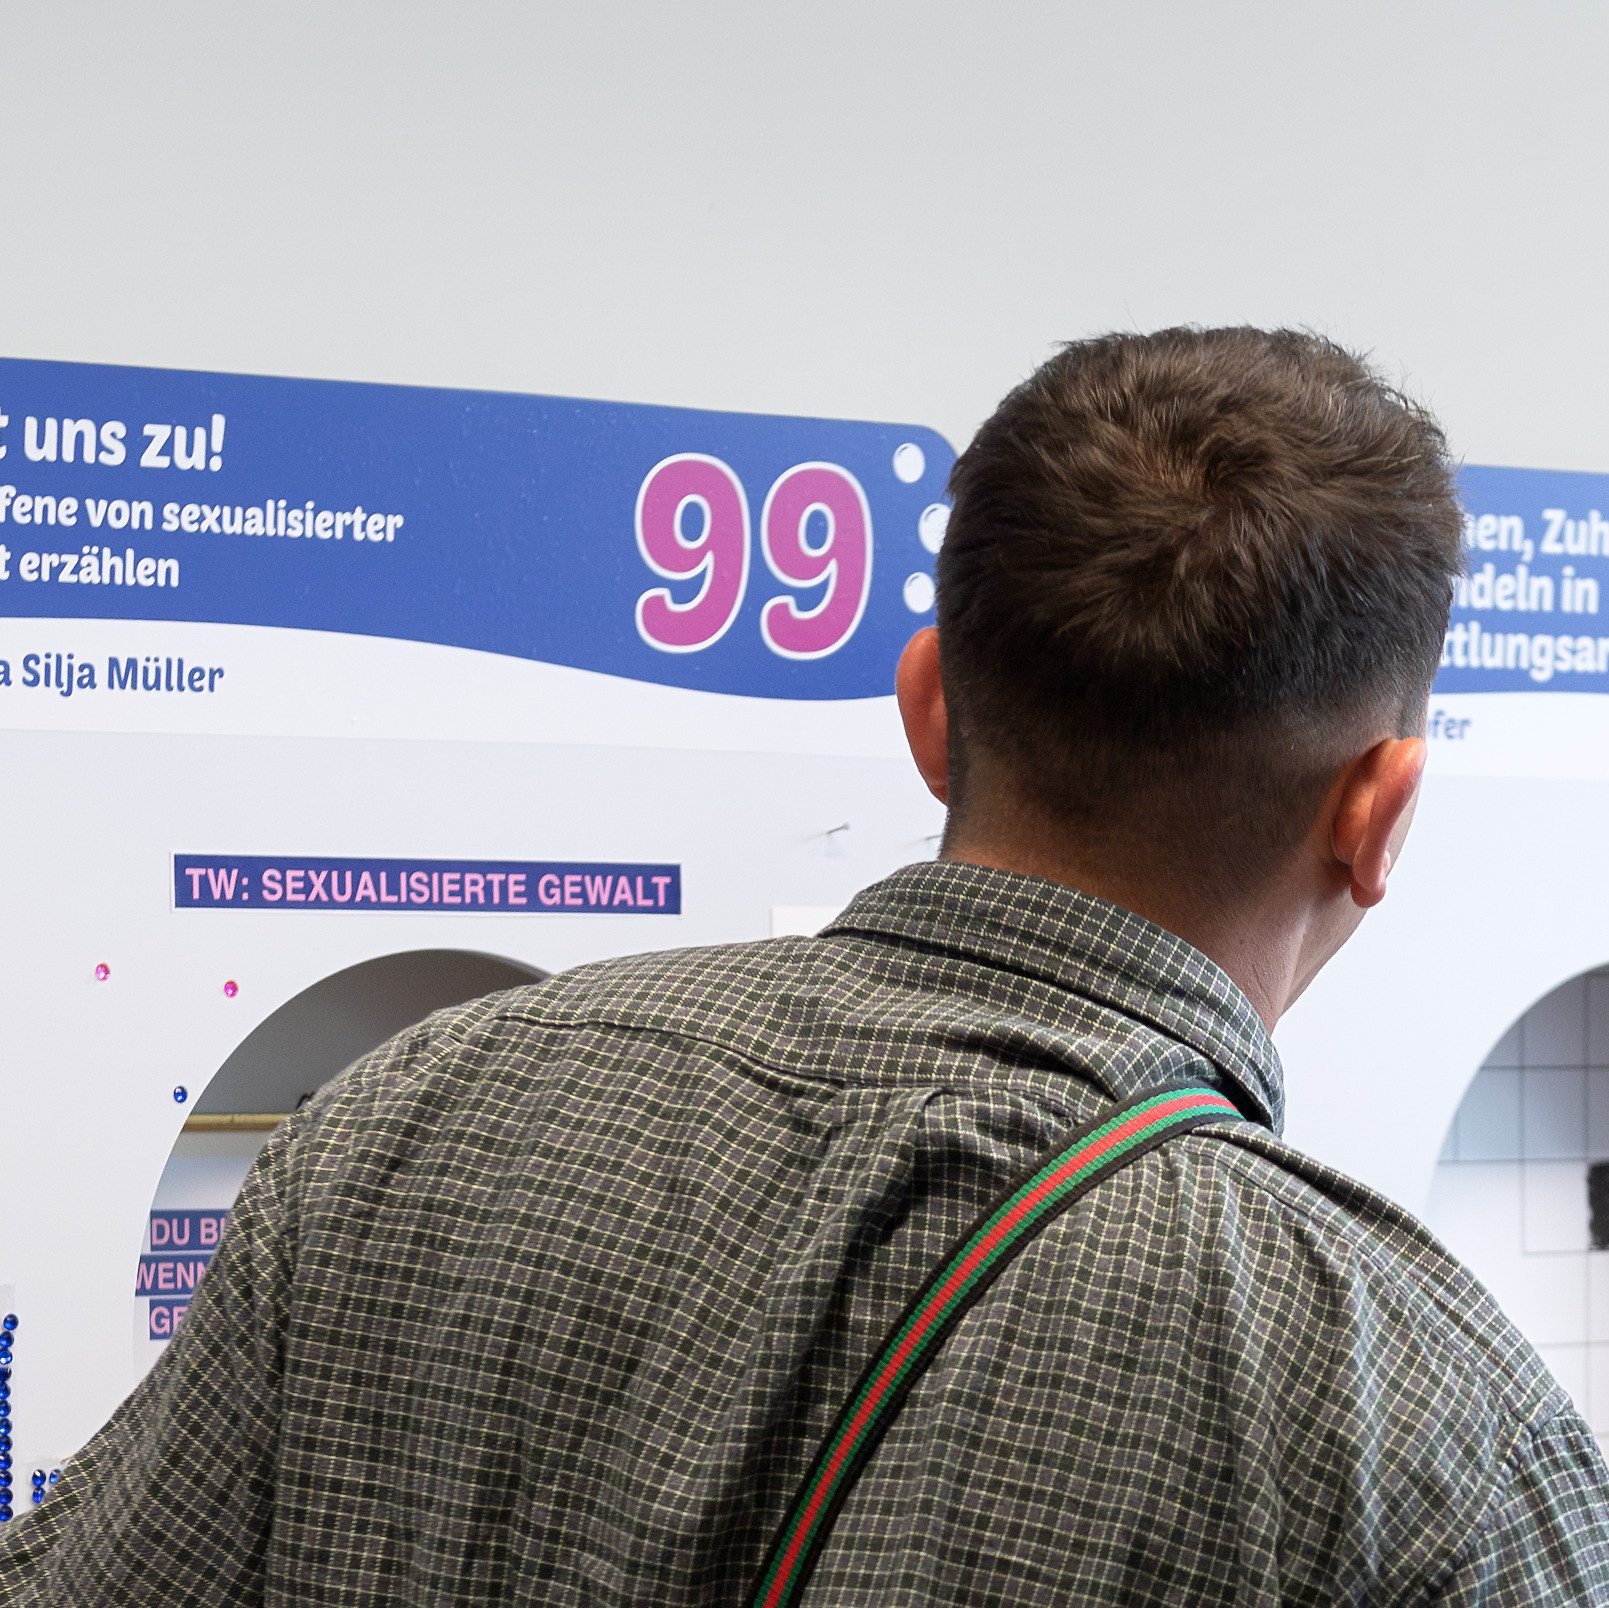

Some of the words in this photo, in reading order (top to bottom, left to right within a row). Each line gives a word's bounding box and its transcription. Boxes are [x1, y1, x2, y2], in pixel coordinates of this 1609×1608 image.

[23, 414, 127, 467] uns
[140, 413, 226, 472] zu!
[85, 496, 153, 531] von
[161, 499, 404, 543] sexualisierter
[19, 545, 179, 588] erzählen
[635, 452, 874, 660] 99
[1560, 566, 1600, 615] in
[21, 652, 97, 697] Silja
[106, 656, 225, 694] Müller
[184, 866, 250, 902] TW:
[261, 868, 528, 906] SEXUALISIERTE
[537, 872, 672, 908] GEWALT
[152, 1217, 190, 1246] DU
